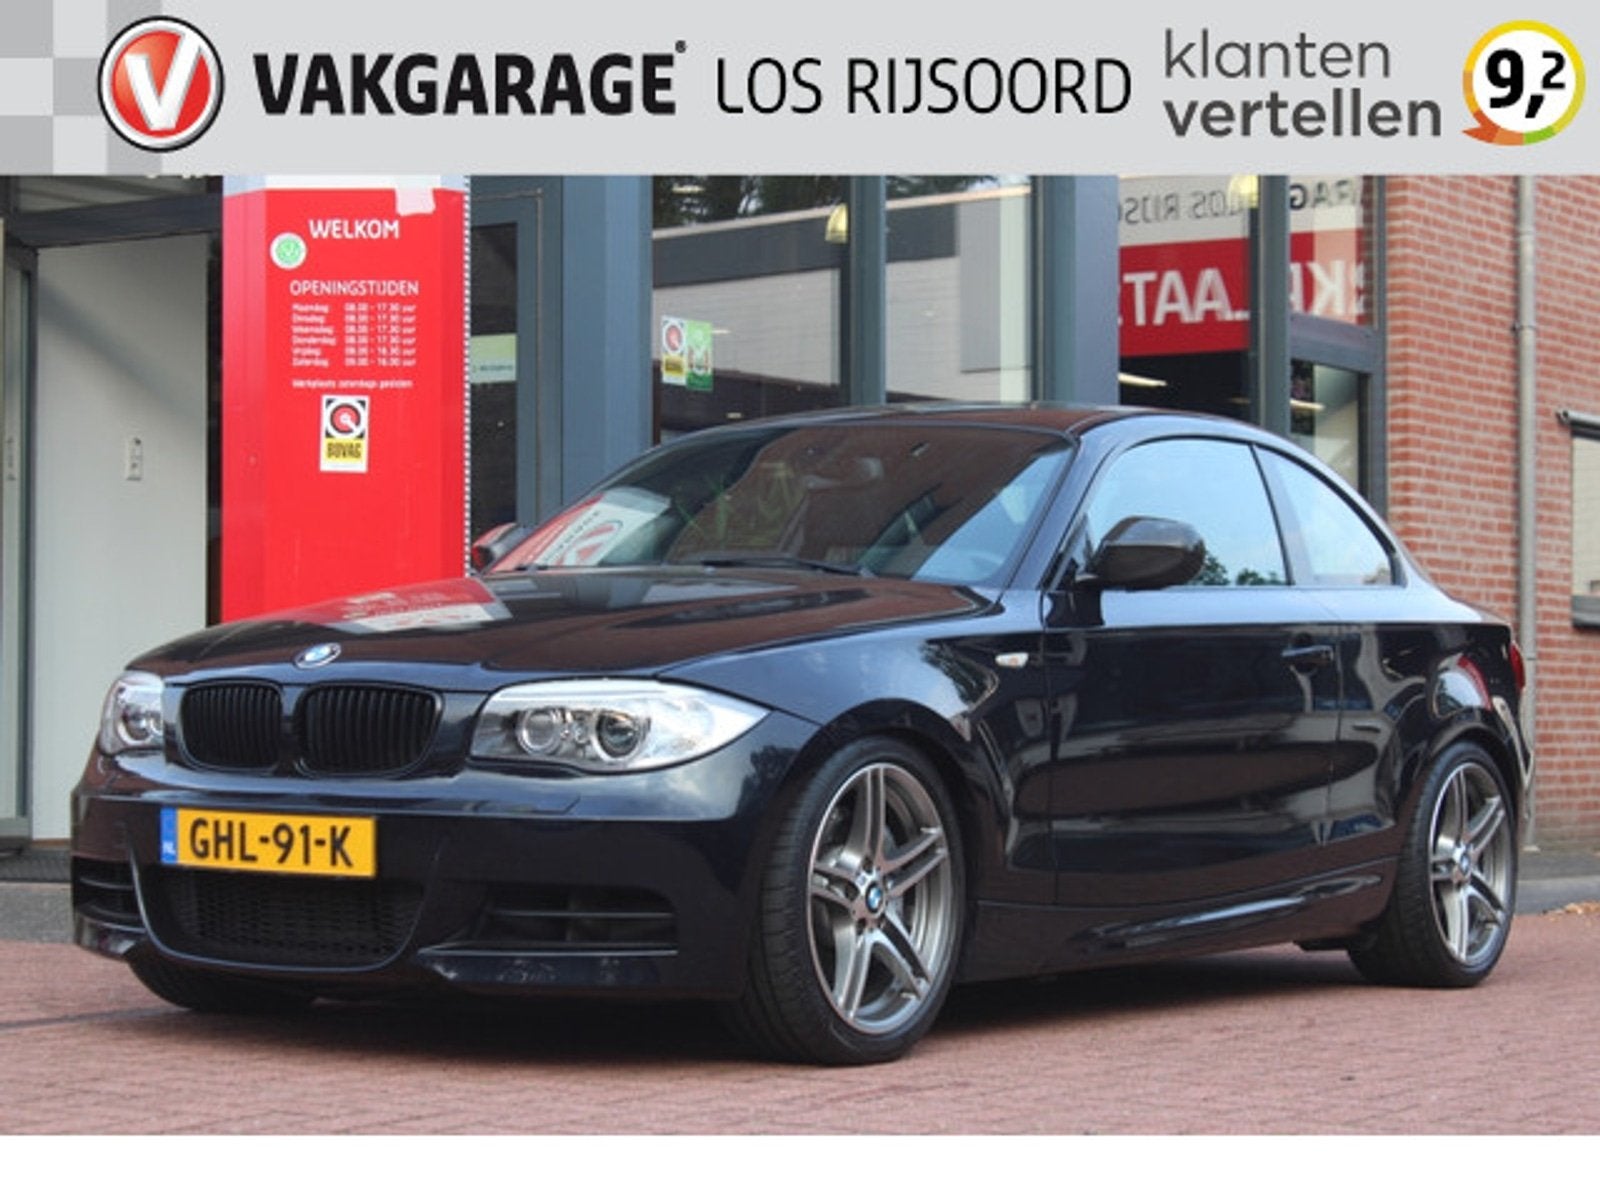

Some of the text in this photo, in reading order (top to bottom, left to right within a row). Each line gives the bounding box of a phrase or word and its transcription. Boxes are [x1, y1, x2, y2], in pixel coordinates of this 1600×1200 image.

[308, 219, 400, 239] WELKOM
[289, 280, 419, 296] OPENINGSTIJDEN
[327, 442, 362, 458] BOVAG
[189, 817, 353, 868] GHL-91-K
